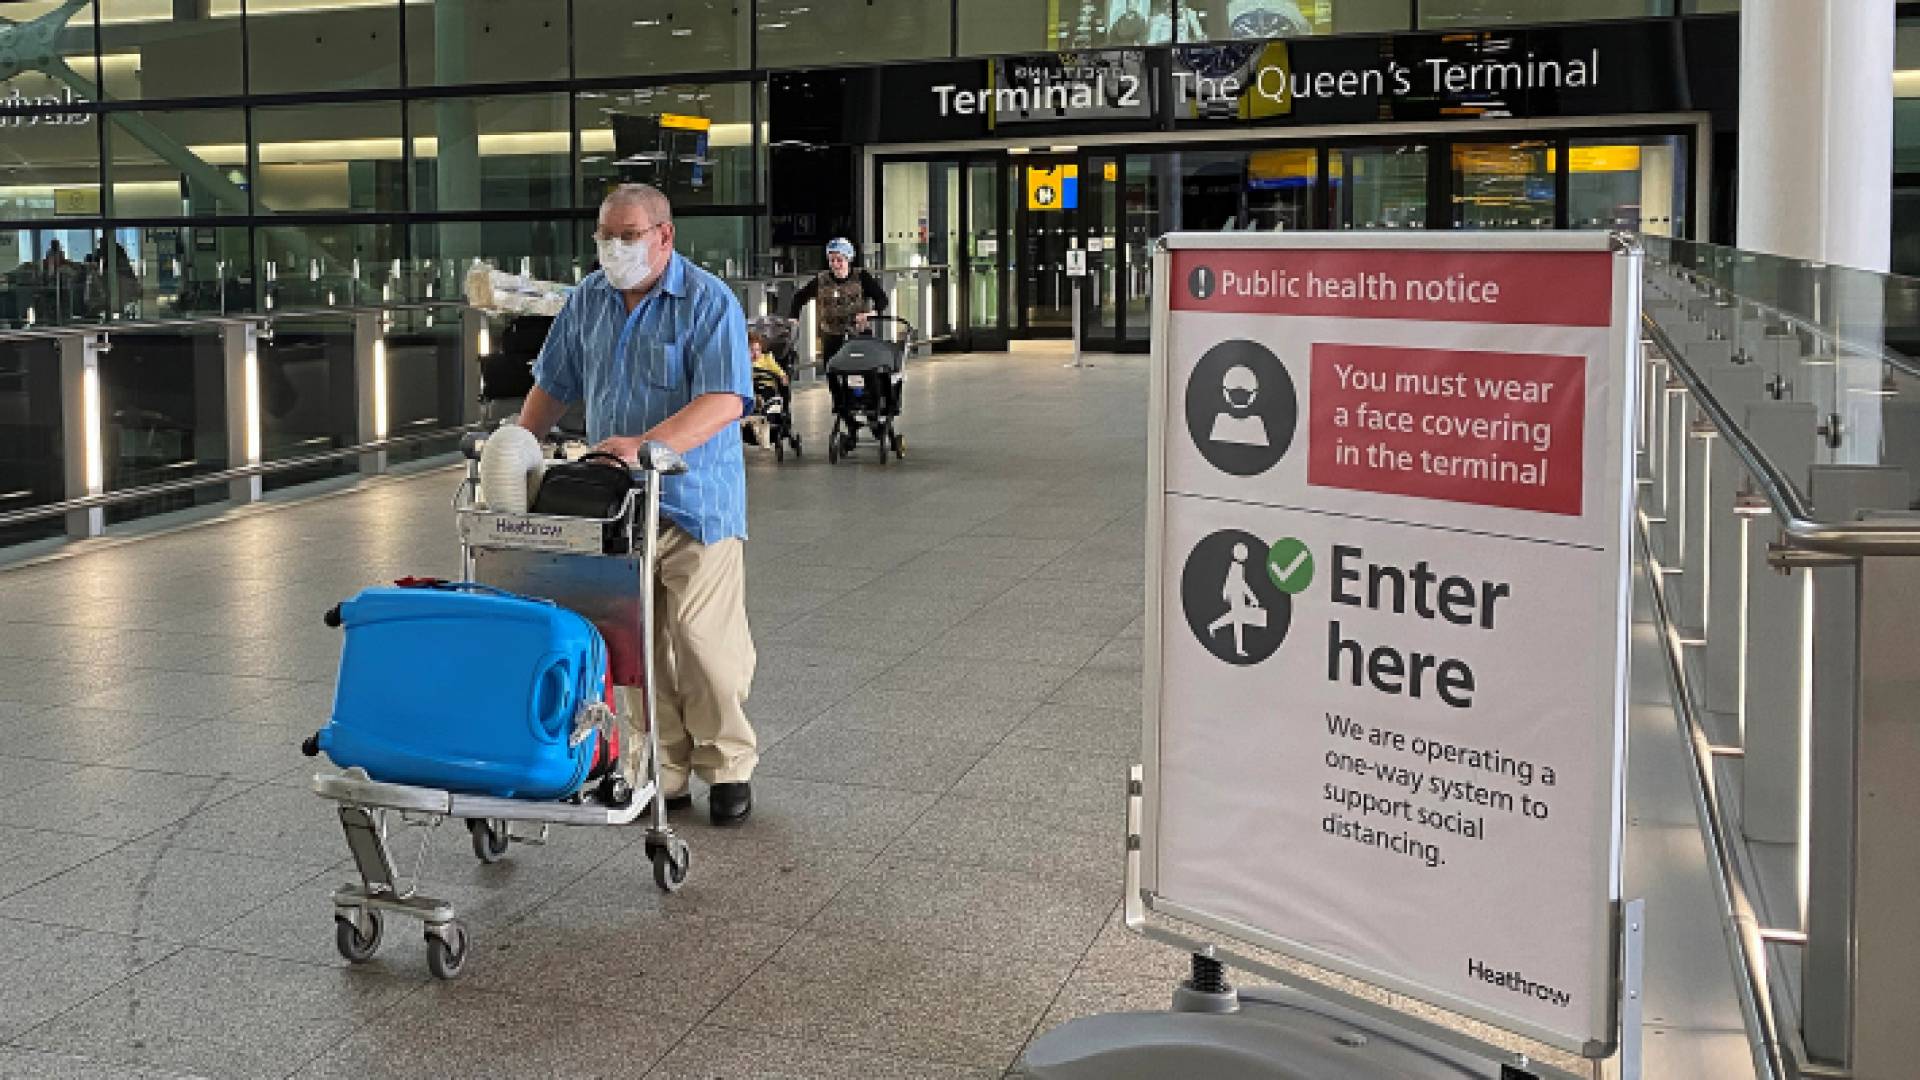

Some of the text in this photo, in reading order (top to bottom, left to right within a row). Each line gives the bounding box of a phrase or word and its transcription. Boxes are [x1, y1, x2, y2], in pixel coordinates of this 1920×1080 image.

[931, 71, 1141, 116] Terminal 2
[1172, 71, 1241, 104] The
[1425, 48, 1599, 92] Terminal
[1221, 270, 1500, 303] Public health notice
[1334, 364, 1554, 404] You must wear
[1333, 402, 1552, 451] a face covering
[1335, 438, 1547, 487] in the terminal
[496, 517, 563, 537] Heathrow
[1331, 545, 1510, 629] Enter
[1328, 620, 1475, 708] here
[1325, 712, 1556, 786] We are operating a
[1325, 750, 1549, 819] one-way system to
[1323, 782, 1484, 840] support social
[1322, 814, 1446, 867] distancing.
[1468, 957, 1570, 1007] Heathrow
